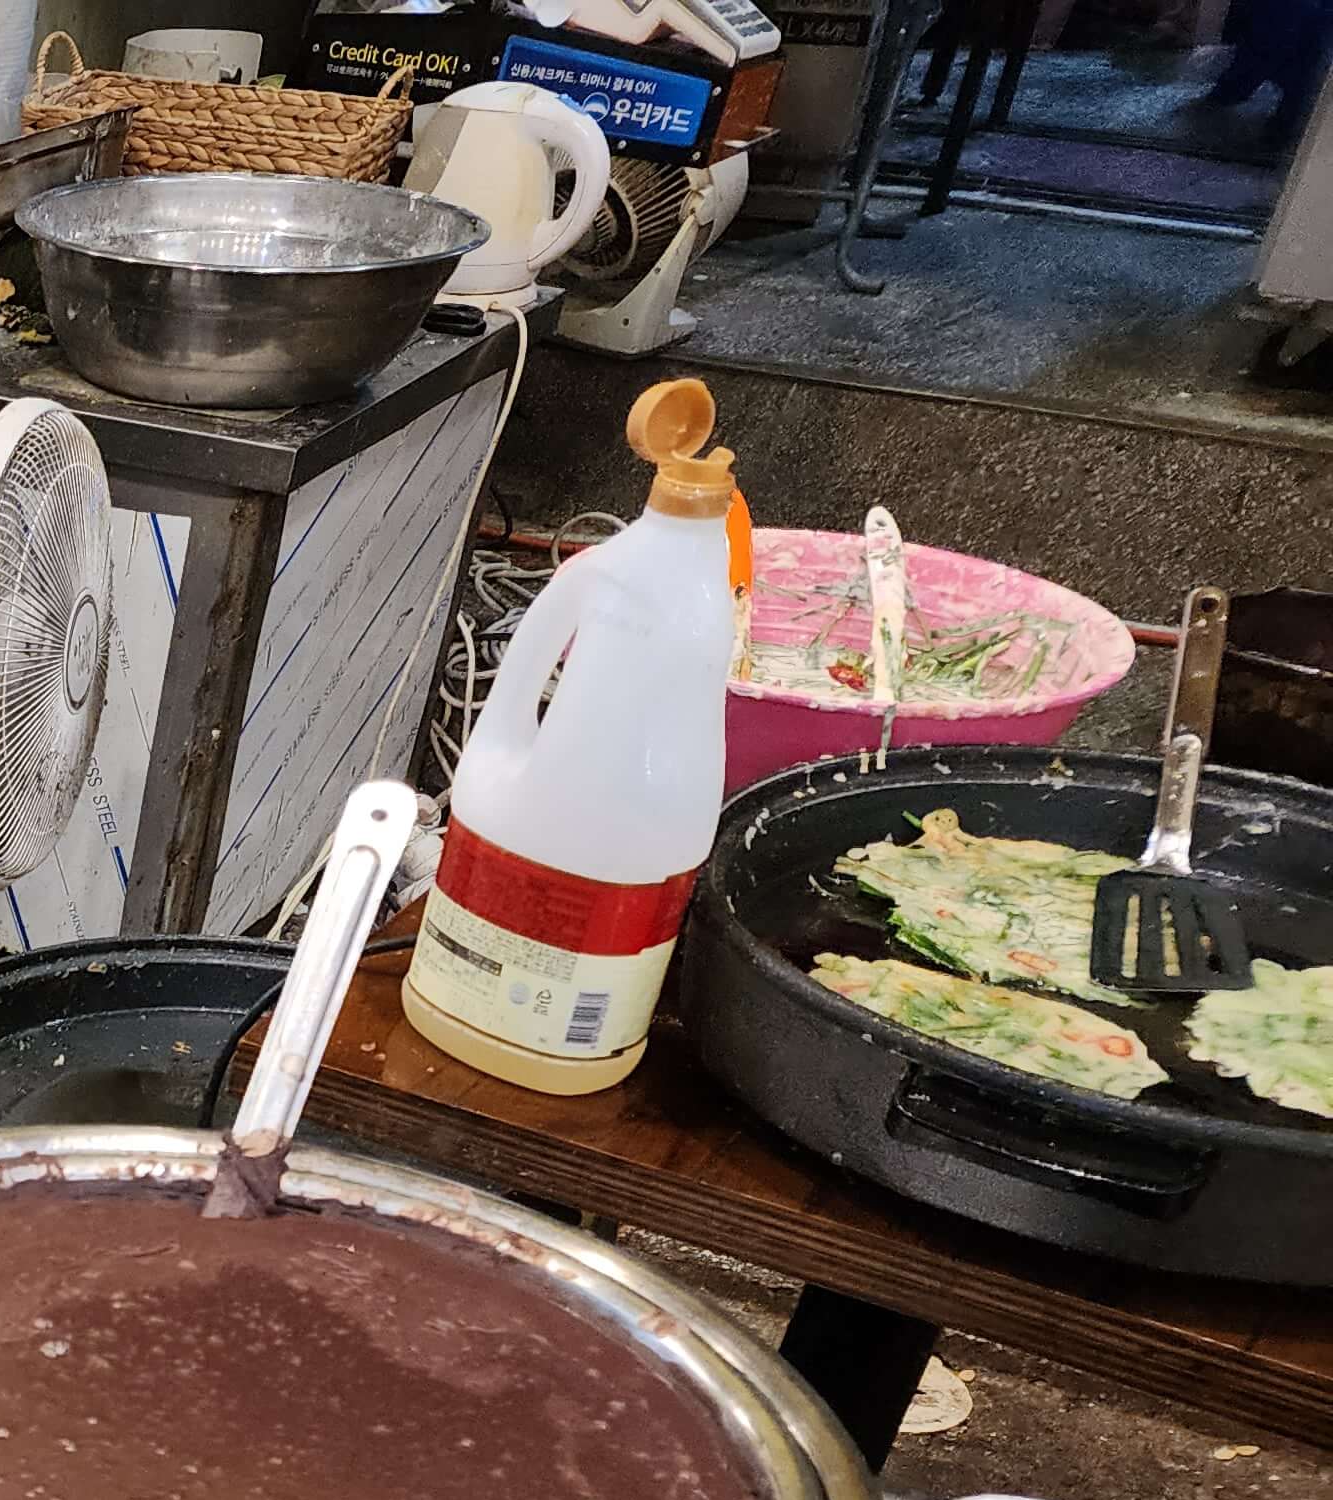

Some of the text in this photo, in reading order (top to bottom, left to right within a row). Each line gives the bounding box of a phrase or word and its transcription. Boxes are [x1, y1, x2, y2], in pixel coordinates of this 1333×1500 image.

[329, 41, 459, 75] Credit Card OK!
[579, 72, 610, 88] 티머니
[611, 98, 693, 133] 우리카드
[92, 794, 120, 841] STEEL
